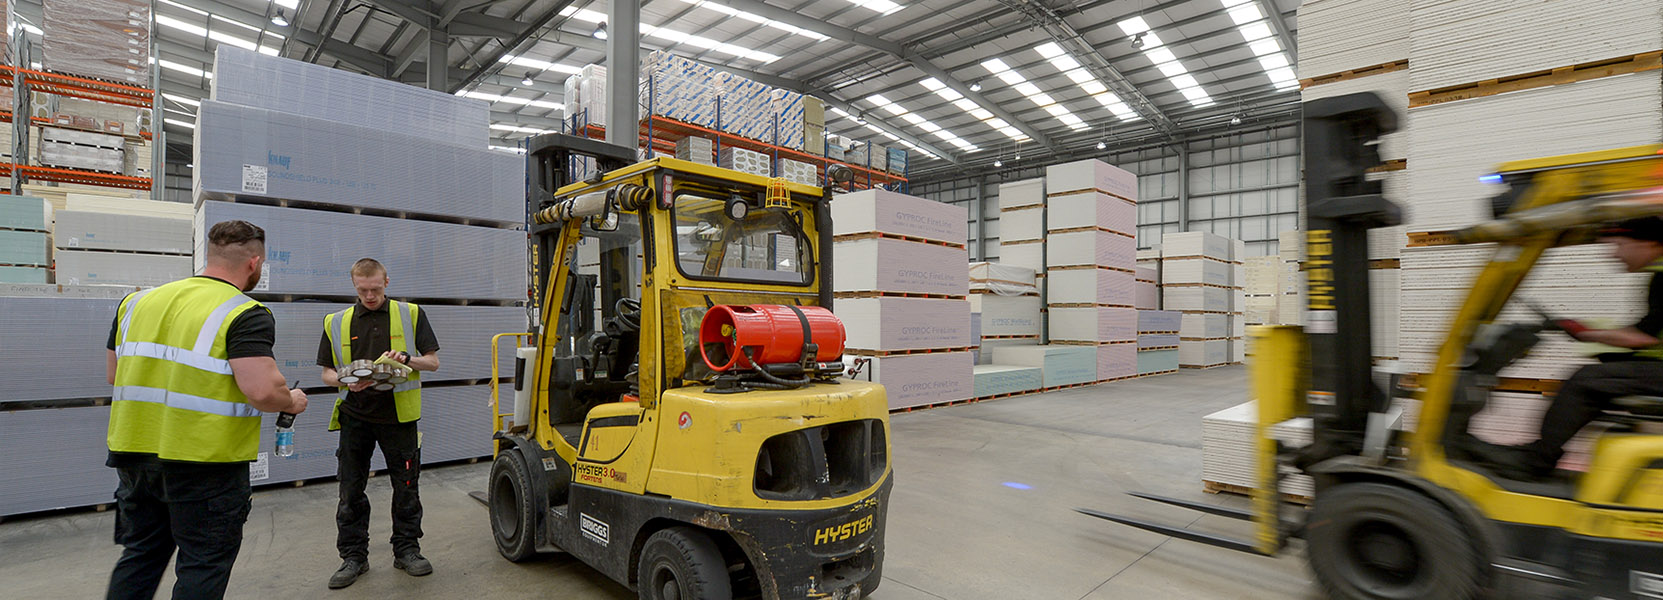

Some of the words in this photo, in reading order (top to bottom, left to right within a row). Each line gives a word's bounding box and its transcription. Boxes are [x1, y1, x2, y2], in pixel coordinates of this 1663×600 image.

[896, 211, 927, 224] GYPROC
[532, 244, 540, 307] HYSTER
[898, 269, 928, 280] GYPROC
[902, 326, 931, 335] GYPROC
[902, 382, 932, 392] GYPROC
[577, 463, 603, 477] HYSTER
[603, 466, 616, 479] 3.0
[582, 517, 607, 538] BRIGGS
[814, 514, 873, 546] HYSTER
